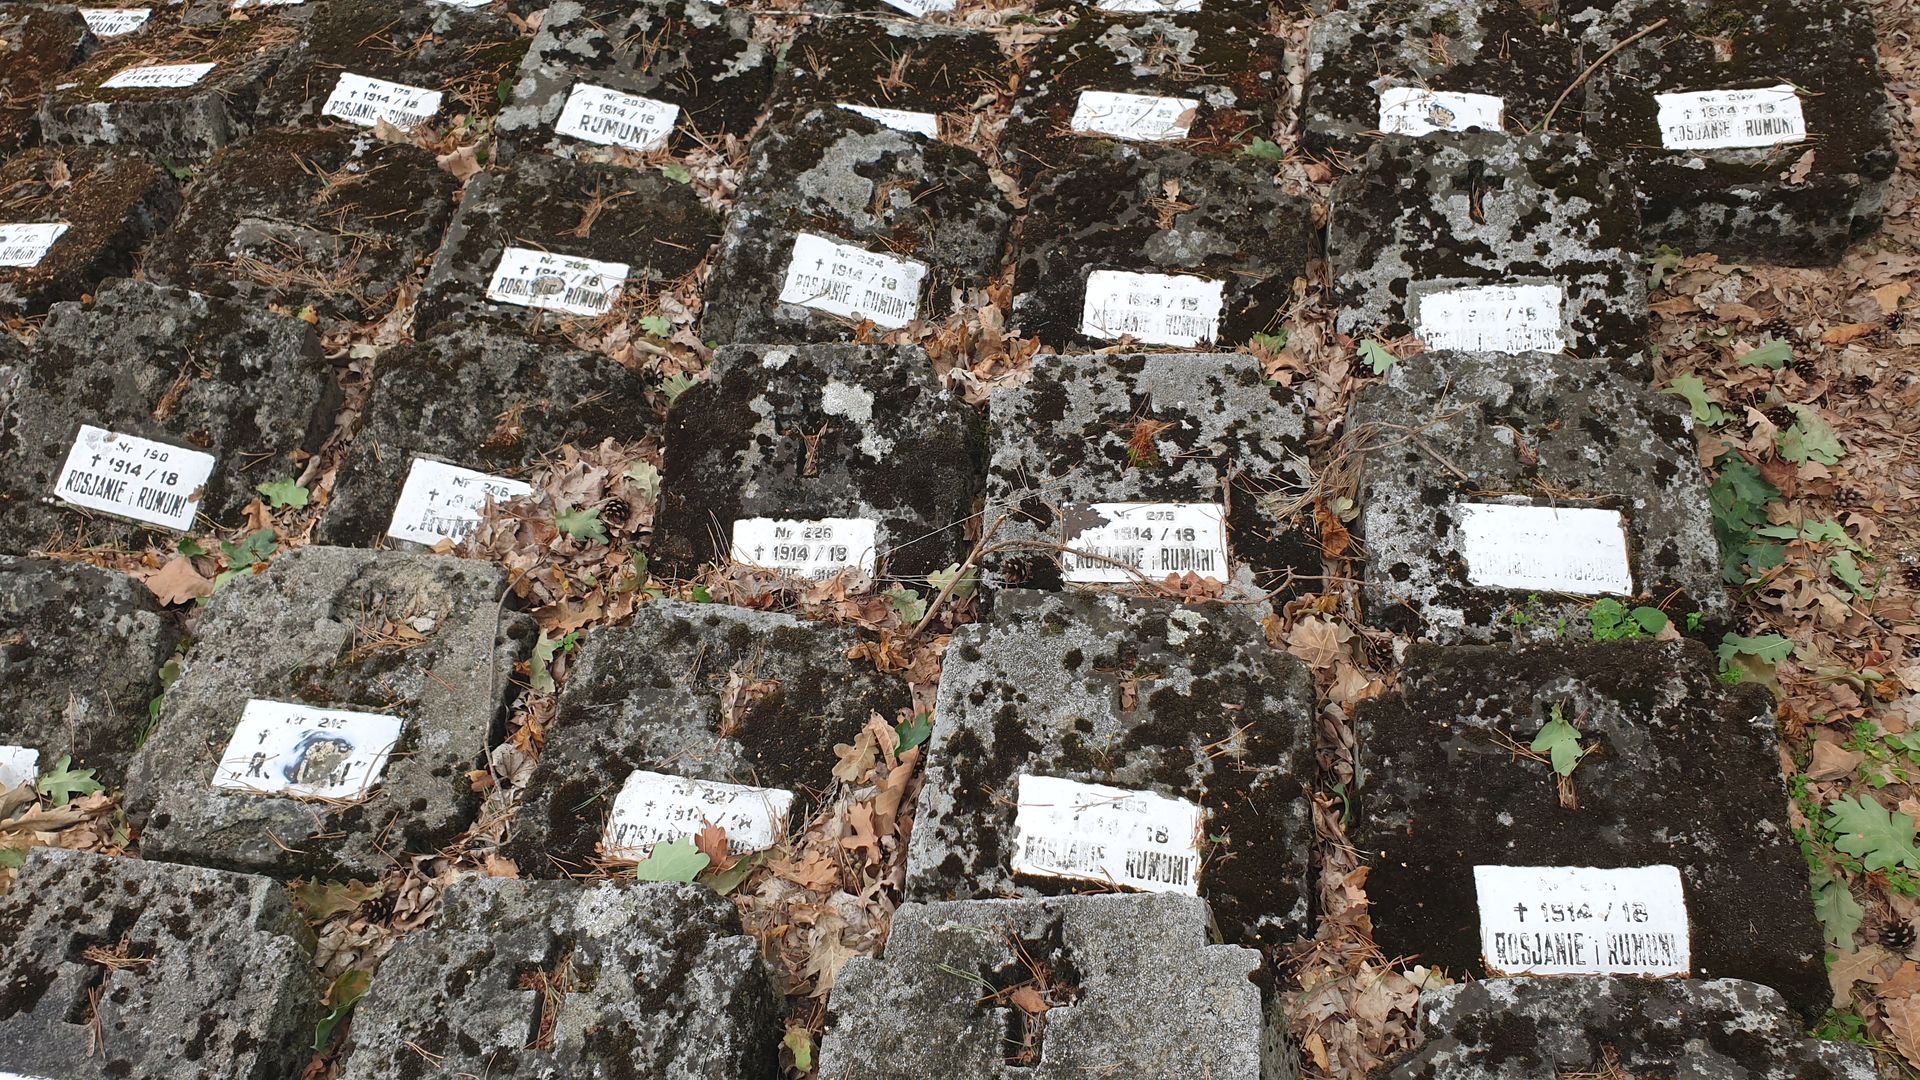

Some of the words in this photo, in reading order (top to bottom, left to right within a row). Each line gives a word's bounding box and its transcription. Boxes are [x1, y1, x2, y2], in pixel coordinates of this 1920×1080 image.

[362, 92, 390, 104] 1914
[603, 93, 617, 102] Nr
[622, 97, 647, 109] 203
[598, 103, 626, 118] 1914
[640, 114, 656, 125] 18
[539, 256, 557, 265] Nr
[116, 442, 134, 455] Nr
[109, 457, 143, 478] 1914
[160, 470, 180, 486] 18
[65, 469, 128, 503] ROSJANIE
[774, 526, 792, 539] Nr
[804, 526, 833, 540] 226
[1174, 527, 1196, 542] 18
[773, 545, 809, 562] 1914
[829, 546, 848, 562] 18
[1160, 547, 1215, 572] RUMUNI
[1494, 931, 1588, 967] ROSJANIE
